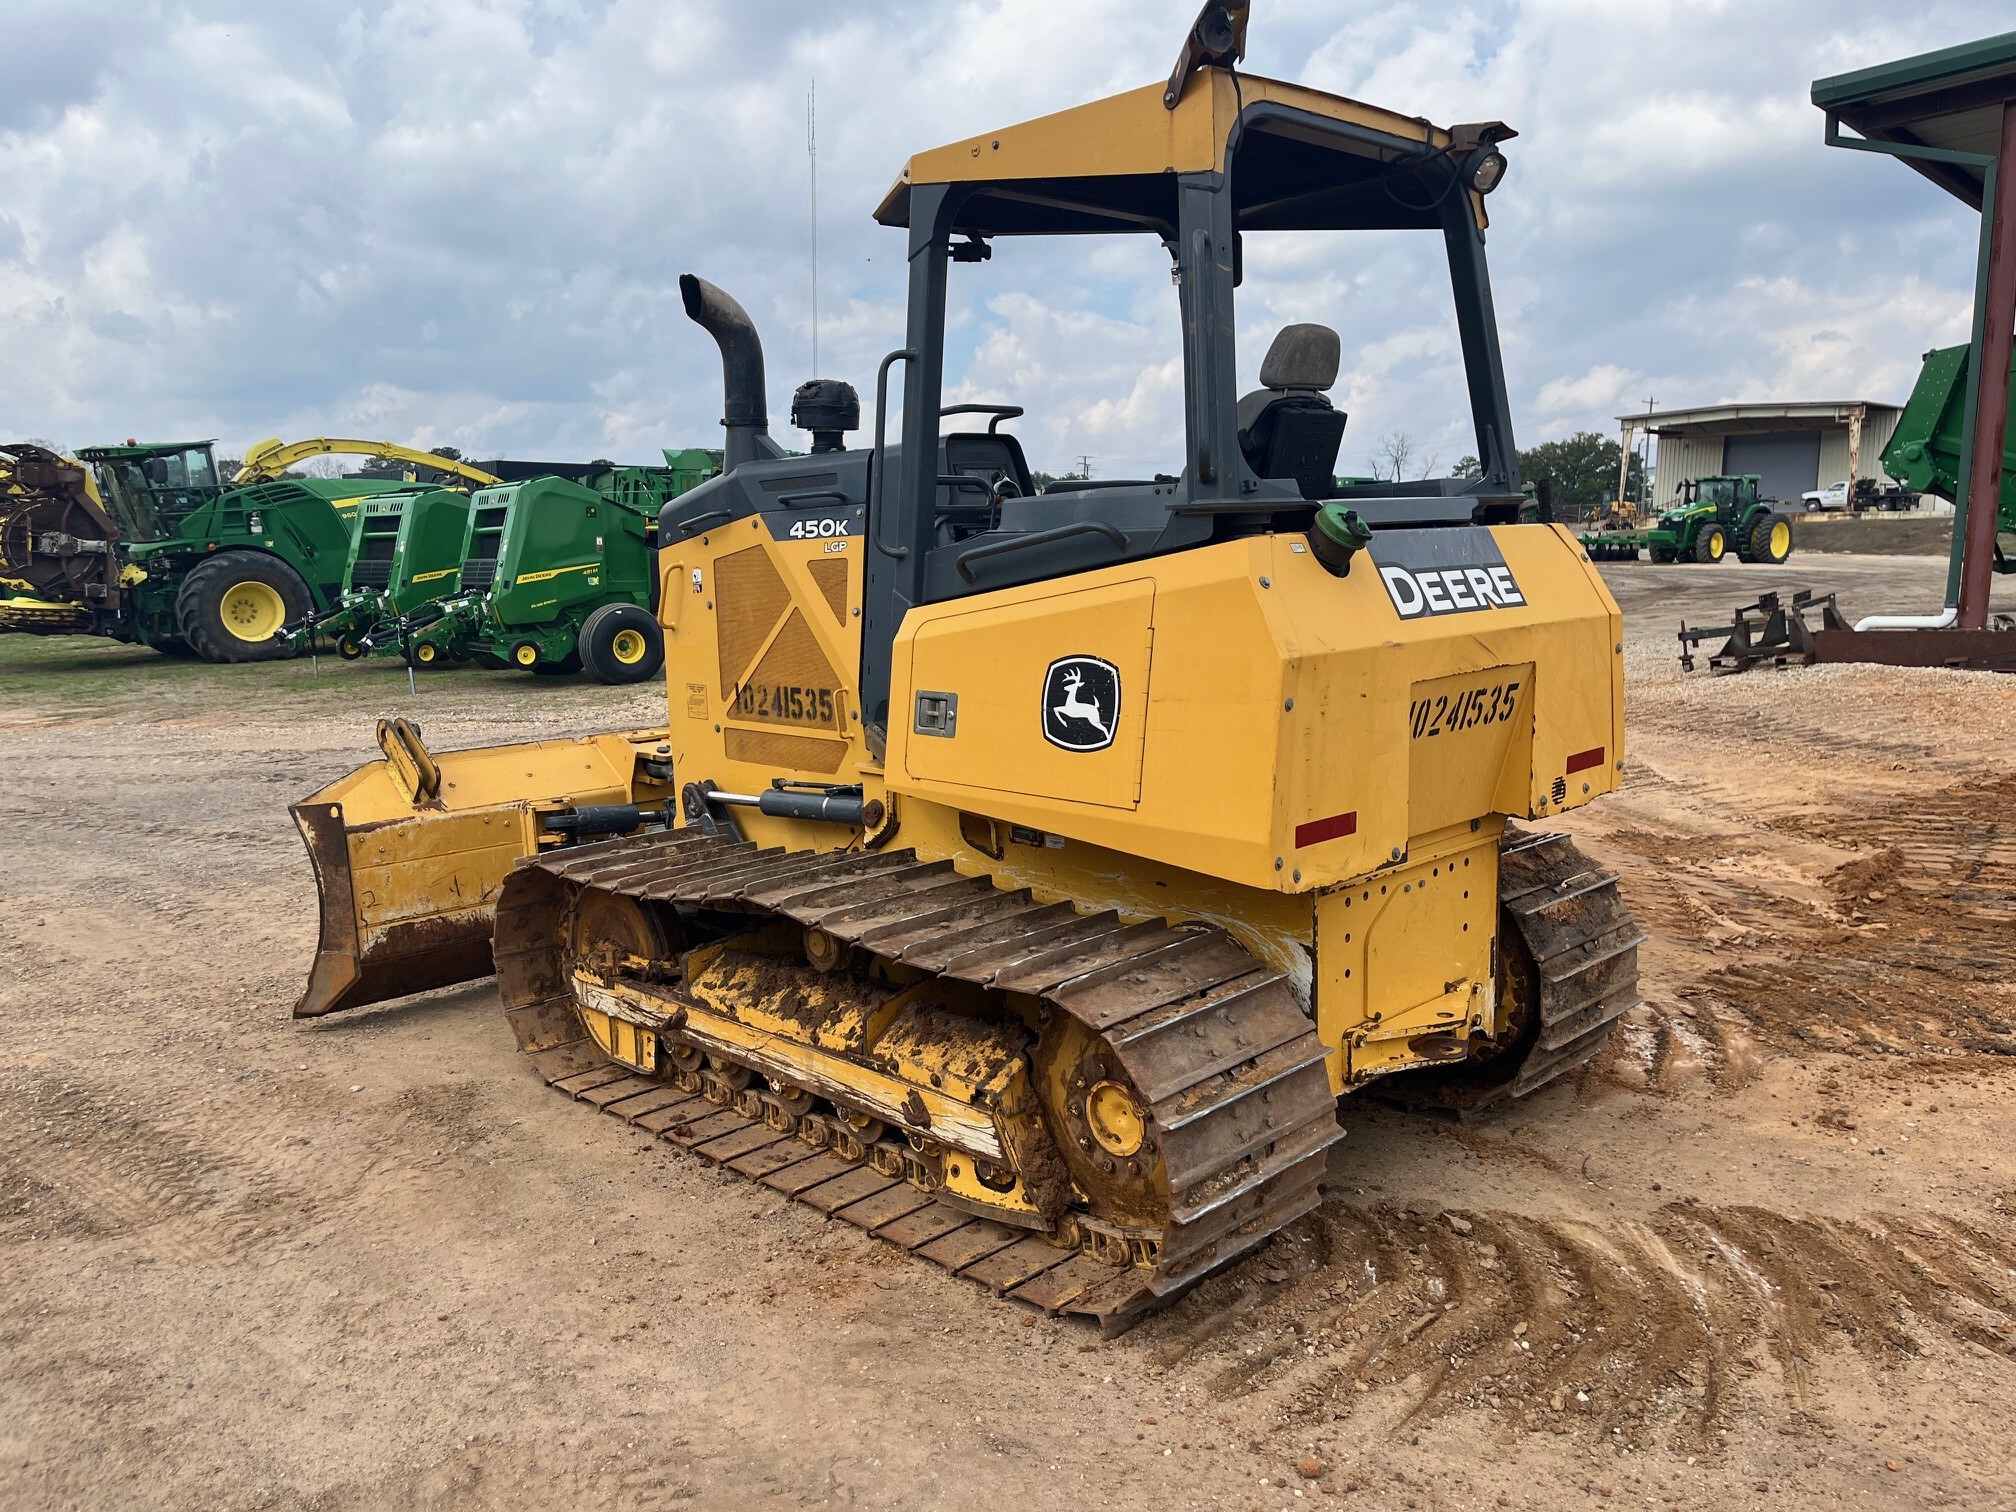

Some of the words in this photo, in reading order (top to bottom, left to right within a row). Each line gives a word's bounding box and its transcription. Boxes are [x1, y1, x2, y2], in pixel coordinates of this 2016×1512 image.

[789, 518, 849, 539] 450K
[824, 541, 848, 553] LGP
[1379, 566, 1524, 616] DEERE
[734, 681, 834, 723] 10241535
[1409, 682, 1520, 740] 10241535
